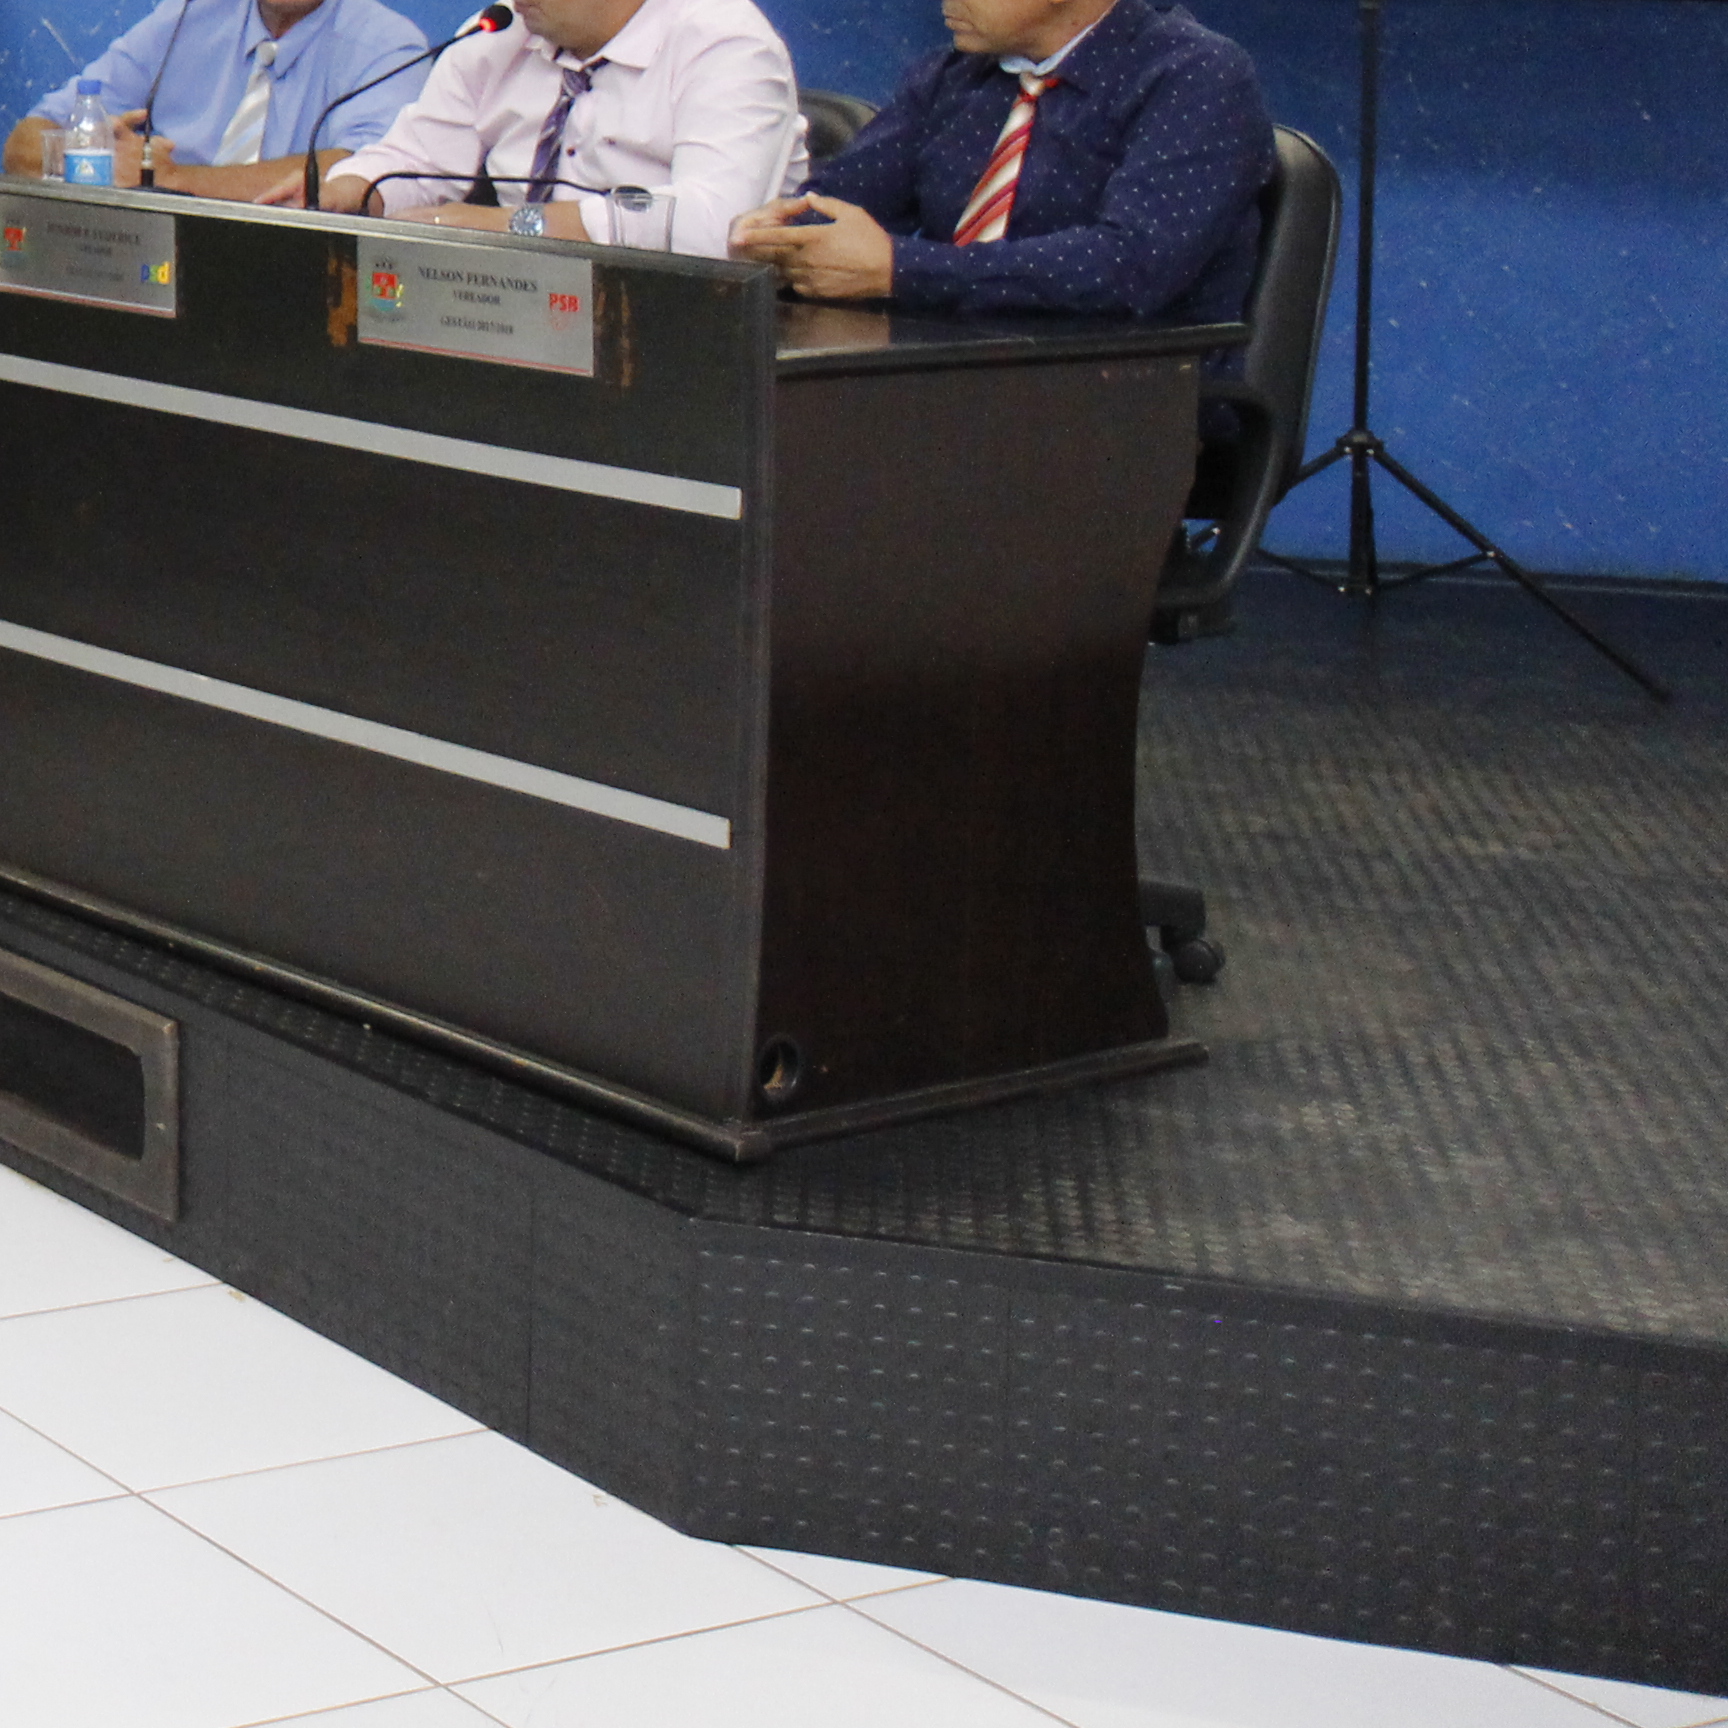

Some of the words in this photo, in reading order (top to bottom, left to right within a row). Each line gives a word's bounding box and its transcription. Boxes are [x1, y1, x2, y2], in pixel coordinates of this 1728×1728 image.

[417, 265, 464, 283] NELSON
[466, 272, 538, 293] FERNANDES
[549, 293, 580, 313] PSB
